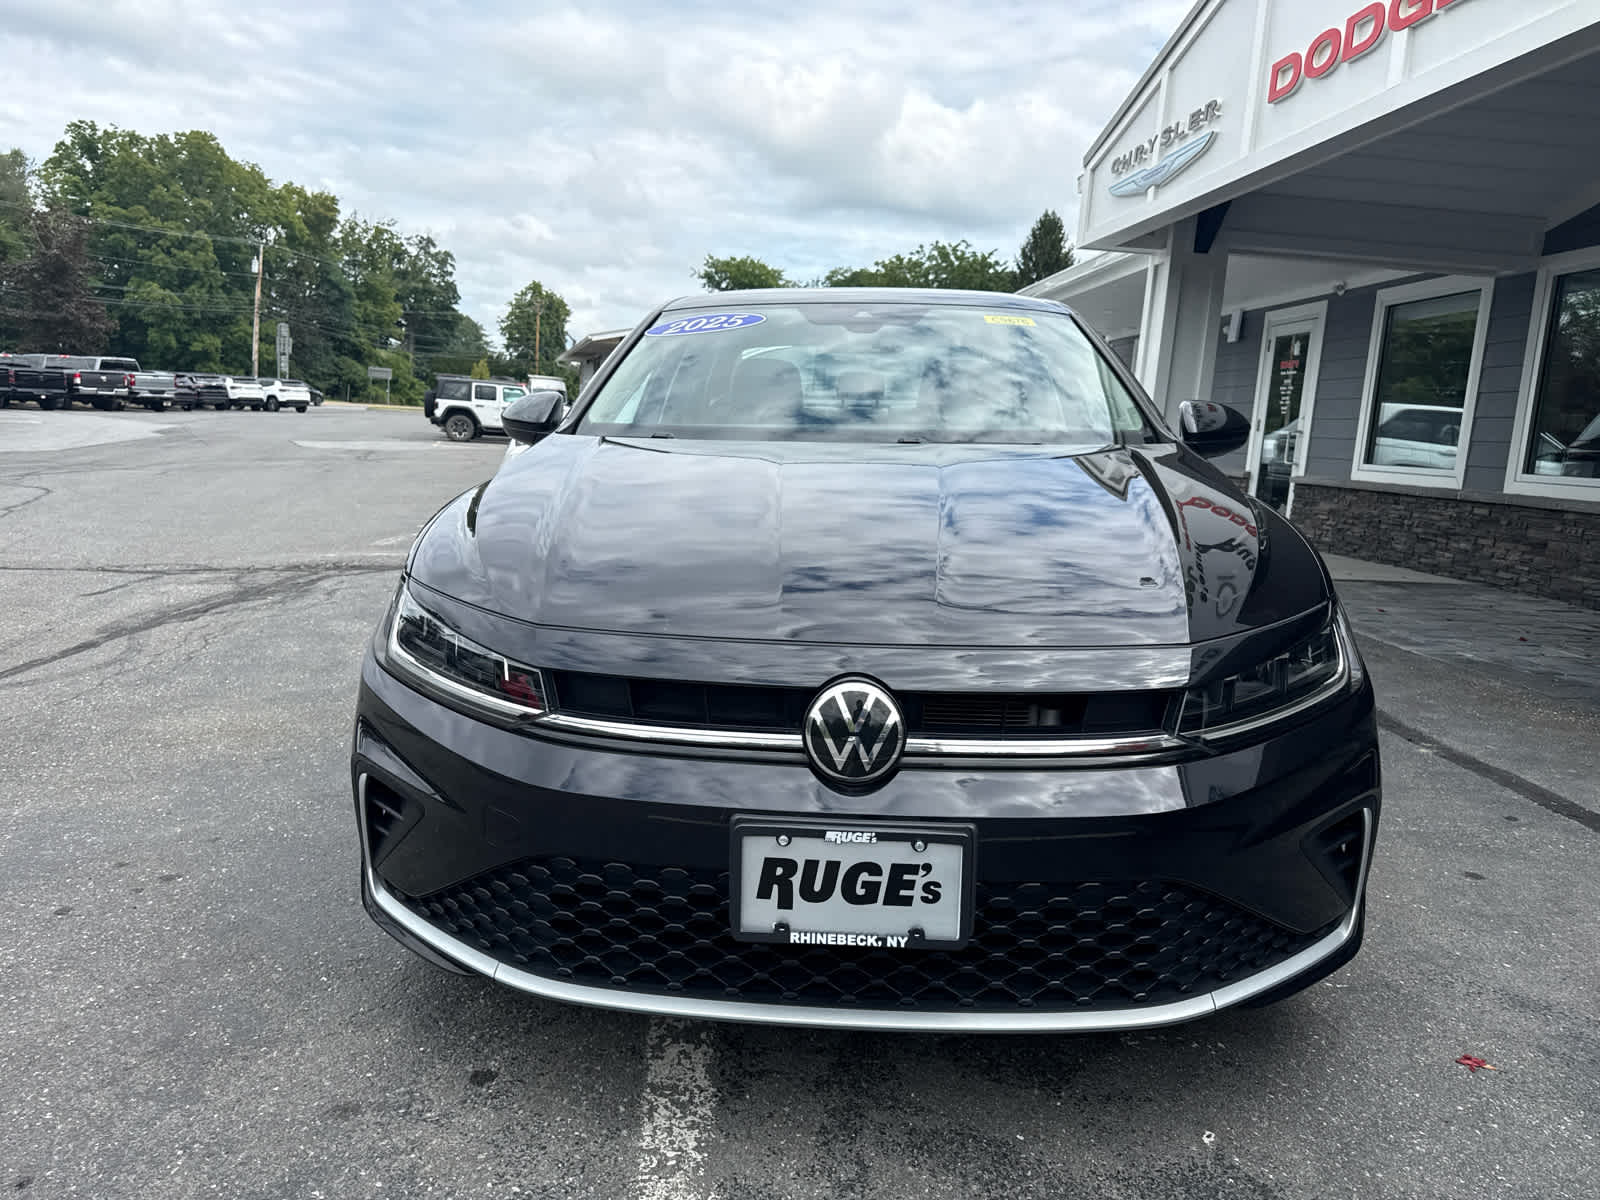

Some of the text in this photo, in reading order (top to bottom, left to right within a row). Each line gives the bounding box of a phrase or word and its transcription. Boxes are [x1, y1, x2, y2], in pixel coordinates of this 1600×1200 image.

[1268, 0, 1456, 104] DODG
[1111, 99, 1223, 175] CHRYSLER
[663, 315, 749, 334] 2025
[756, 857, 943, 911] RUGE's
[790, 933, 909, 949] RHINEBECK, NY
